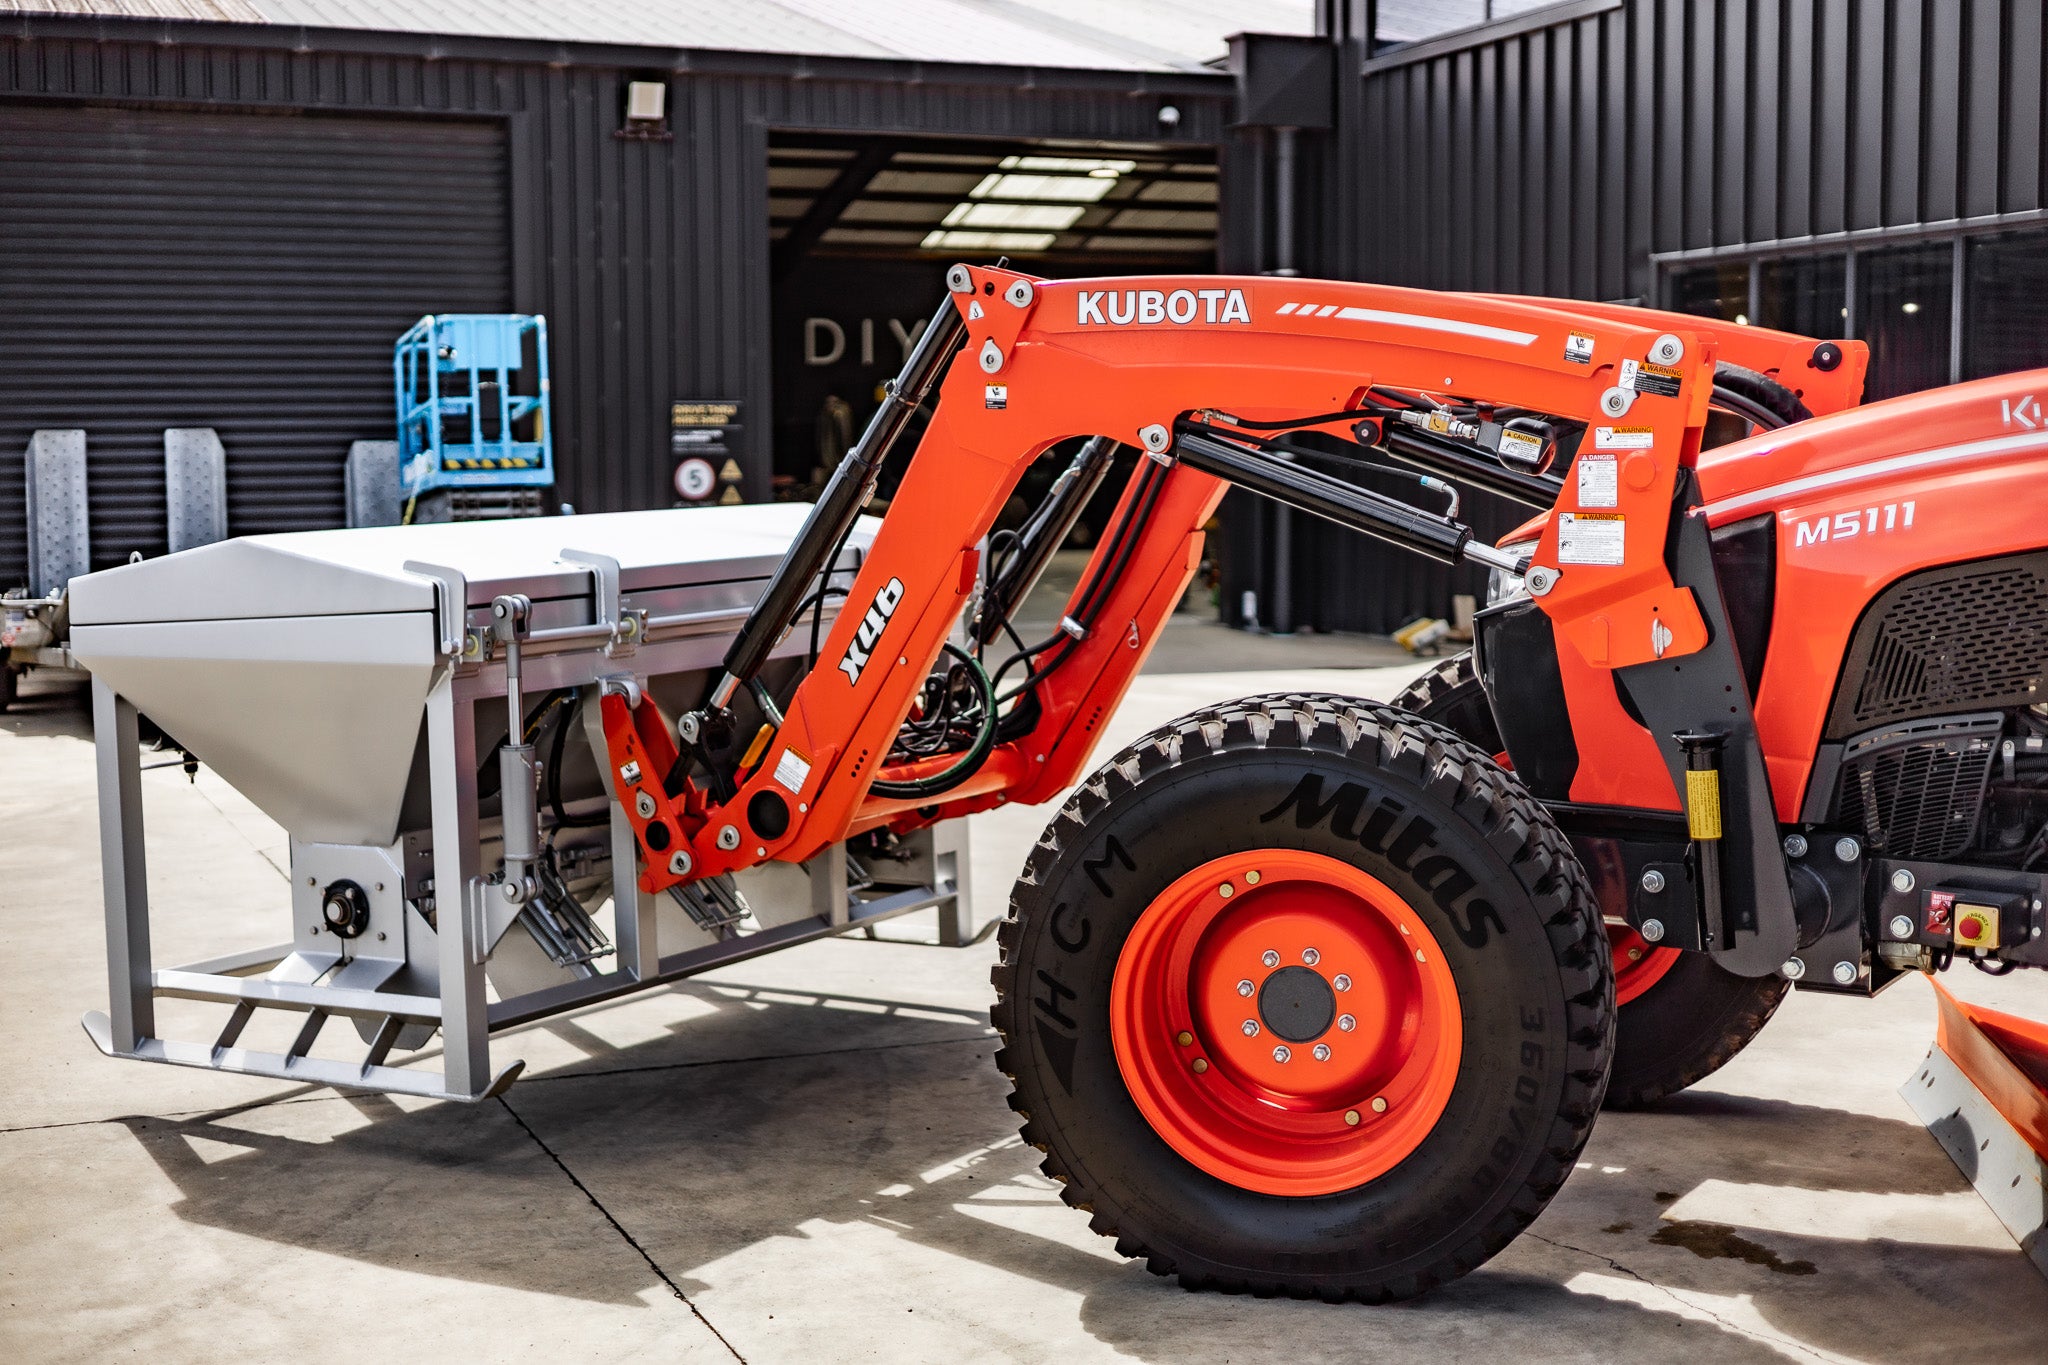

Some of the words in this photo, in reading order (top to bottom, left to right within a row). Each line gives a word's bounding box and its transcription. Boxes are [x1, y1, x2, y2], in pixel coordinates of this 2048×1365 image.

[1078, 289, 1251, 325] KUBOTA
[804, 318, 927, 365] DIY
[1647, 364, 1682, 377] WARNING
[1513, 433, 1538, 443] CAUTION
[689, 469, 702, 489] 5
[1588, 513, 1619, 521] WARNING
[1795, 501, 1916, 547] M5111
[838, 576, 905, 687] X46
[1260, 773, 1507, 948] Mitas
